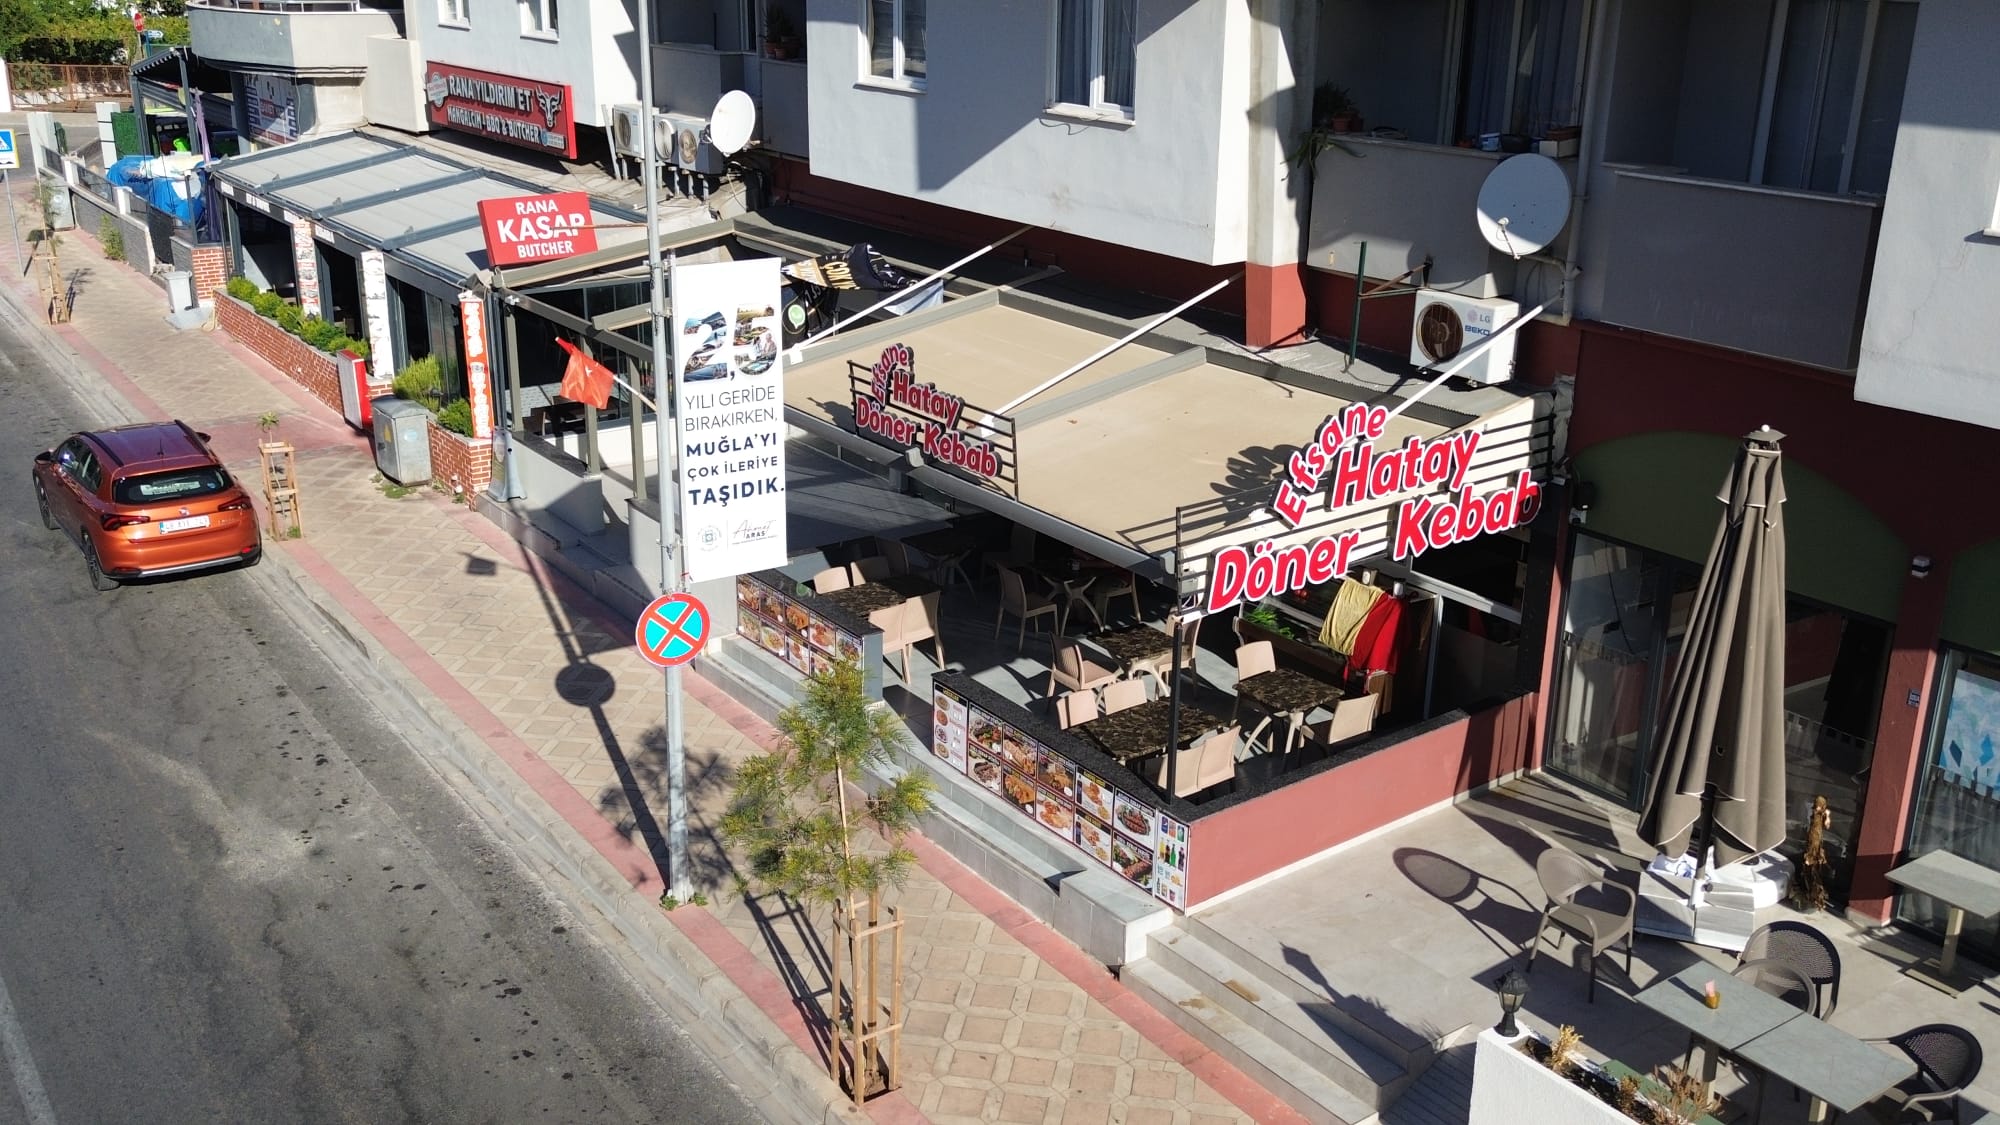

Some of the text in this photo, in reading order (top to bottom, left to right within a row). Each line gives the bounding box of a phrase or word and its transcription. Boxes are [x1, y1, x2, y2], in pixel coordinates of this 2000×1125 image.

[448, 75, 474, 98] RANA
[474, 80, 516, 109] YILDIRIM
[518, 88, 533, 112] ET
[486, 115, 501, 134] BBQ
[508, 121, 541, 144] BUTCHER
[515, 200, 559, 215] RANA
[496, 213, 586, 243] KASAP
[517, 240, 575, 258] BUTCHER
[1464, 325, 1491, 337] BEKO
[1479, 313, 1491, 323] LG
[683, 304, 778, 383] 2,5
[871, 342, 909, 405] Efsane
[685, 384, 776, 410] YILI GERİDE
[893, 370, 961, 429] Hatay
[685, 407, 778, 432] BIRAKIRKEN,
[686, 432, 777, 458] MUĞLA'YI
[856, 395, 997, 478] Döner Kebab
[687, 455, 778, 482] ÇOK İLERİYE
[1273, 402, 1390, 527] Efsane
[1331, 429, 1482, 511] Hatay
[688, 476, 785, 508] TAŞIDIK.
[745, 530, 766, 539] ARAS
[1207, 468, 1543, 615] Döner Kebab
